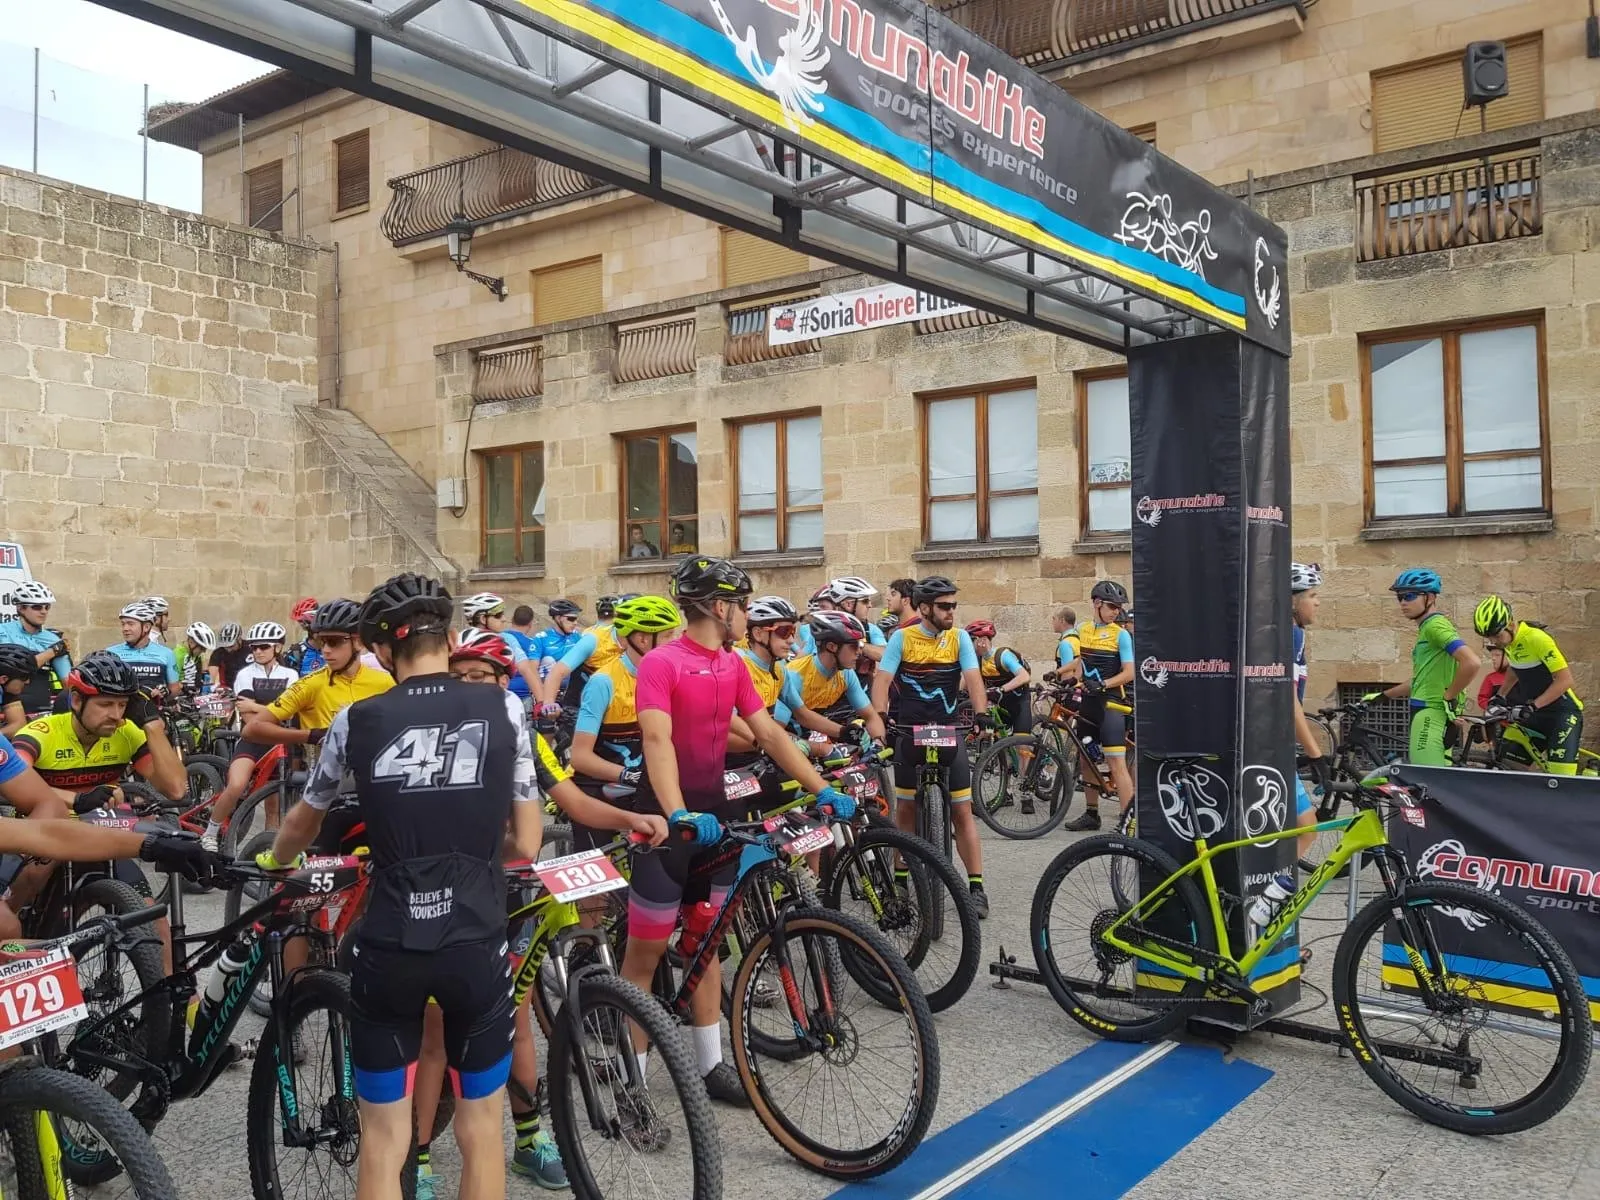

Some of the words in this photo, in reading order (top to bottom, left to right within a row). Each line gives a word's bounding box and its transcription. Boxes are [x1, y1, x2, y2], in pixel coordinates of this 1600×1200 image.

[760, 0, 1046, 160] munabike
[857, 74, 957, 140] sports
[961, 130, 1078, 205] experience
[799, 289, 974, 335] #SoriaQuiereFut
[371, 719, 489, 793] 41
[850, 772, 866, 783] 79
[97, 808, 117, 818] 51
[304, 858, 344, 870] MARCHA
[554, 863, 606, 889] 130
[310, 873, 334, 893] 55
[410, 890, 442, 905] BELIEVE
[444, 887, 453, 899] IN
[1264, 860, 1336, 940] ORBEA
[409, 900, 453, 919] YOURSELF
[0, 974, 64, 1026] 129
[1073, 1007, 1117, 1031] MAXXIS
[1340, 1004, 1372, 1061] MAXXIS
[279, 1063, 299, 1118] BRAIN
